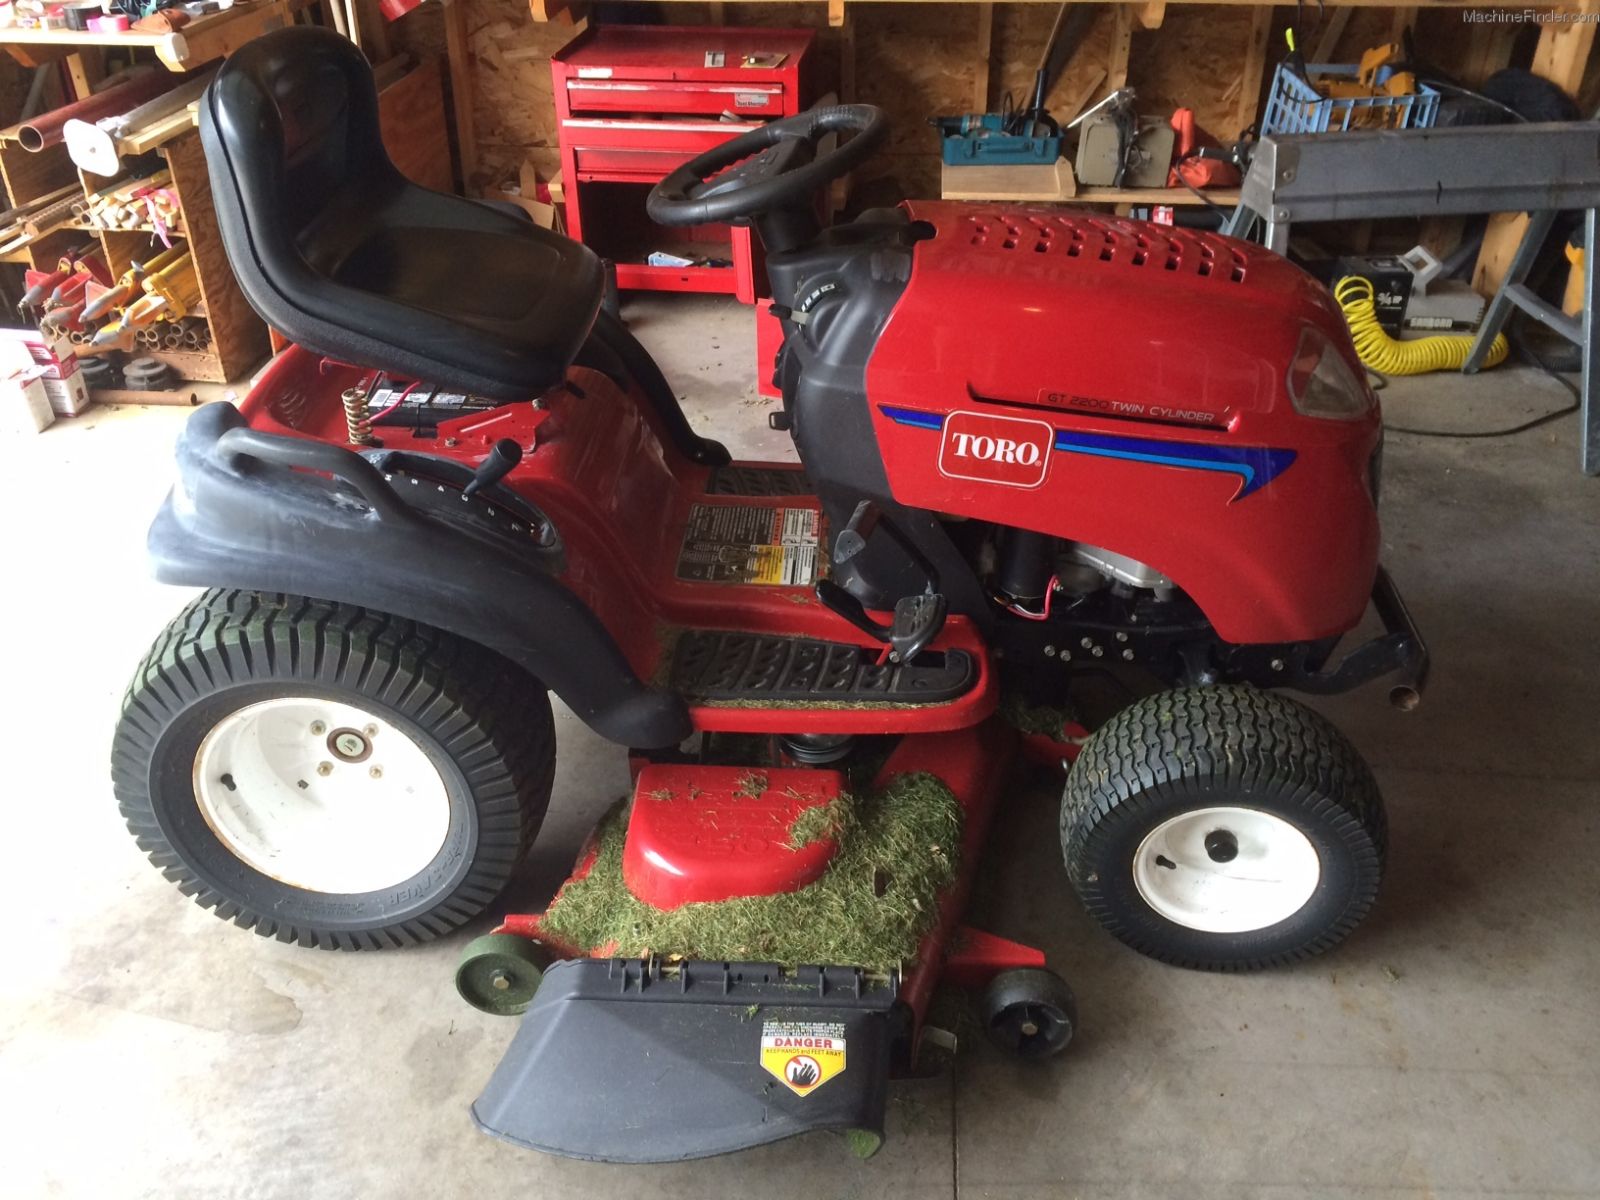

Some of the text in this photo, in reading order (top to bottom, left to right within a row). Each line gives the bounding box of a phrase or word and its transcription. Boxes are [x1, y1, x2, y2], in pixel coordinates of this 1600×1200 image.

[1048, 393, 1215, 422] GT 2200 TWIN CYLINDER
[952, 432, 1040, 466] TORO
[775, 1038, 833, 1048] DANGER
